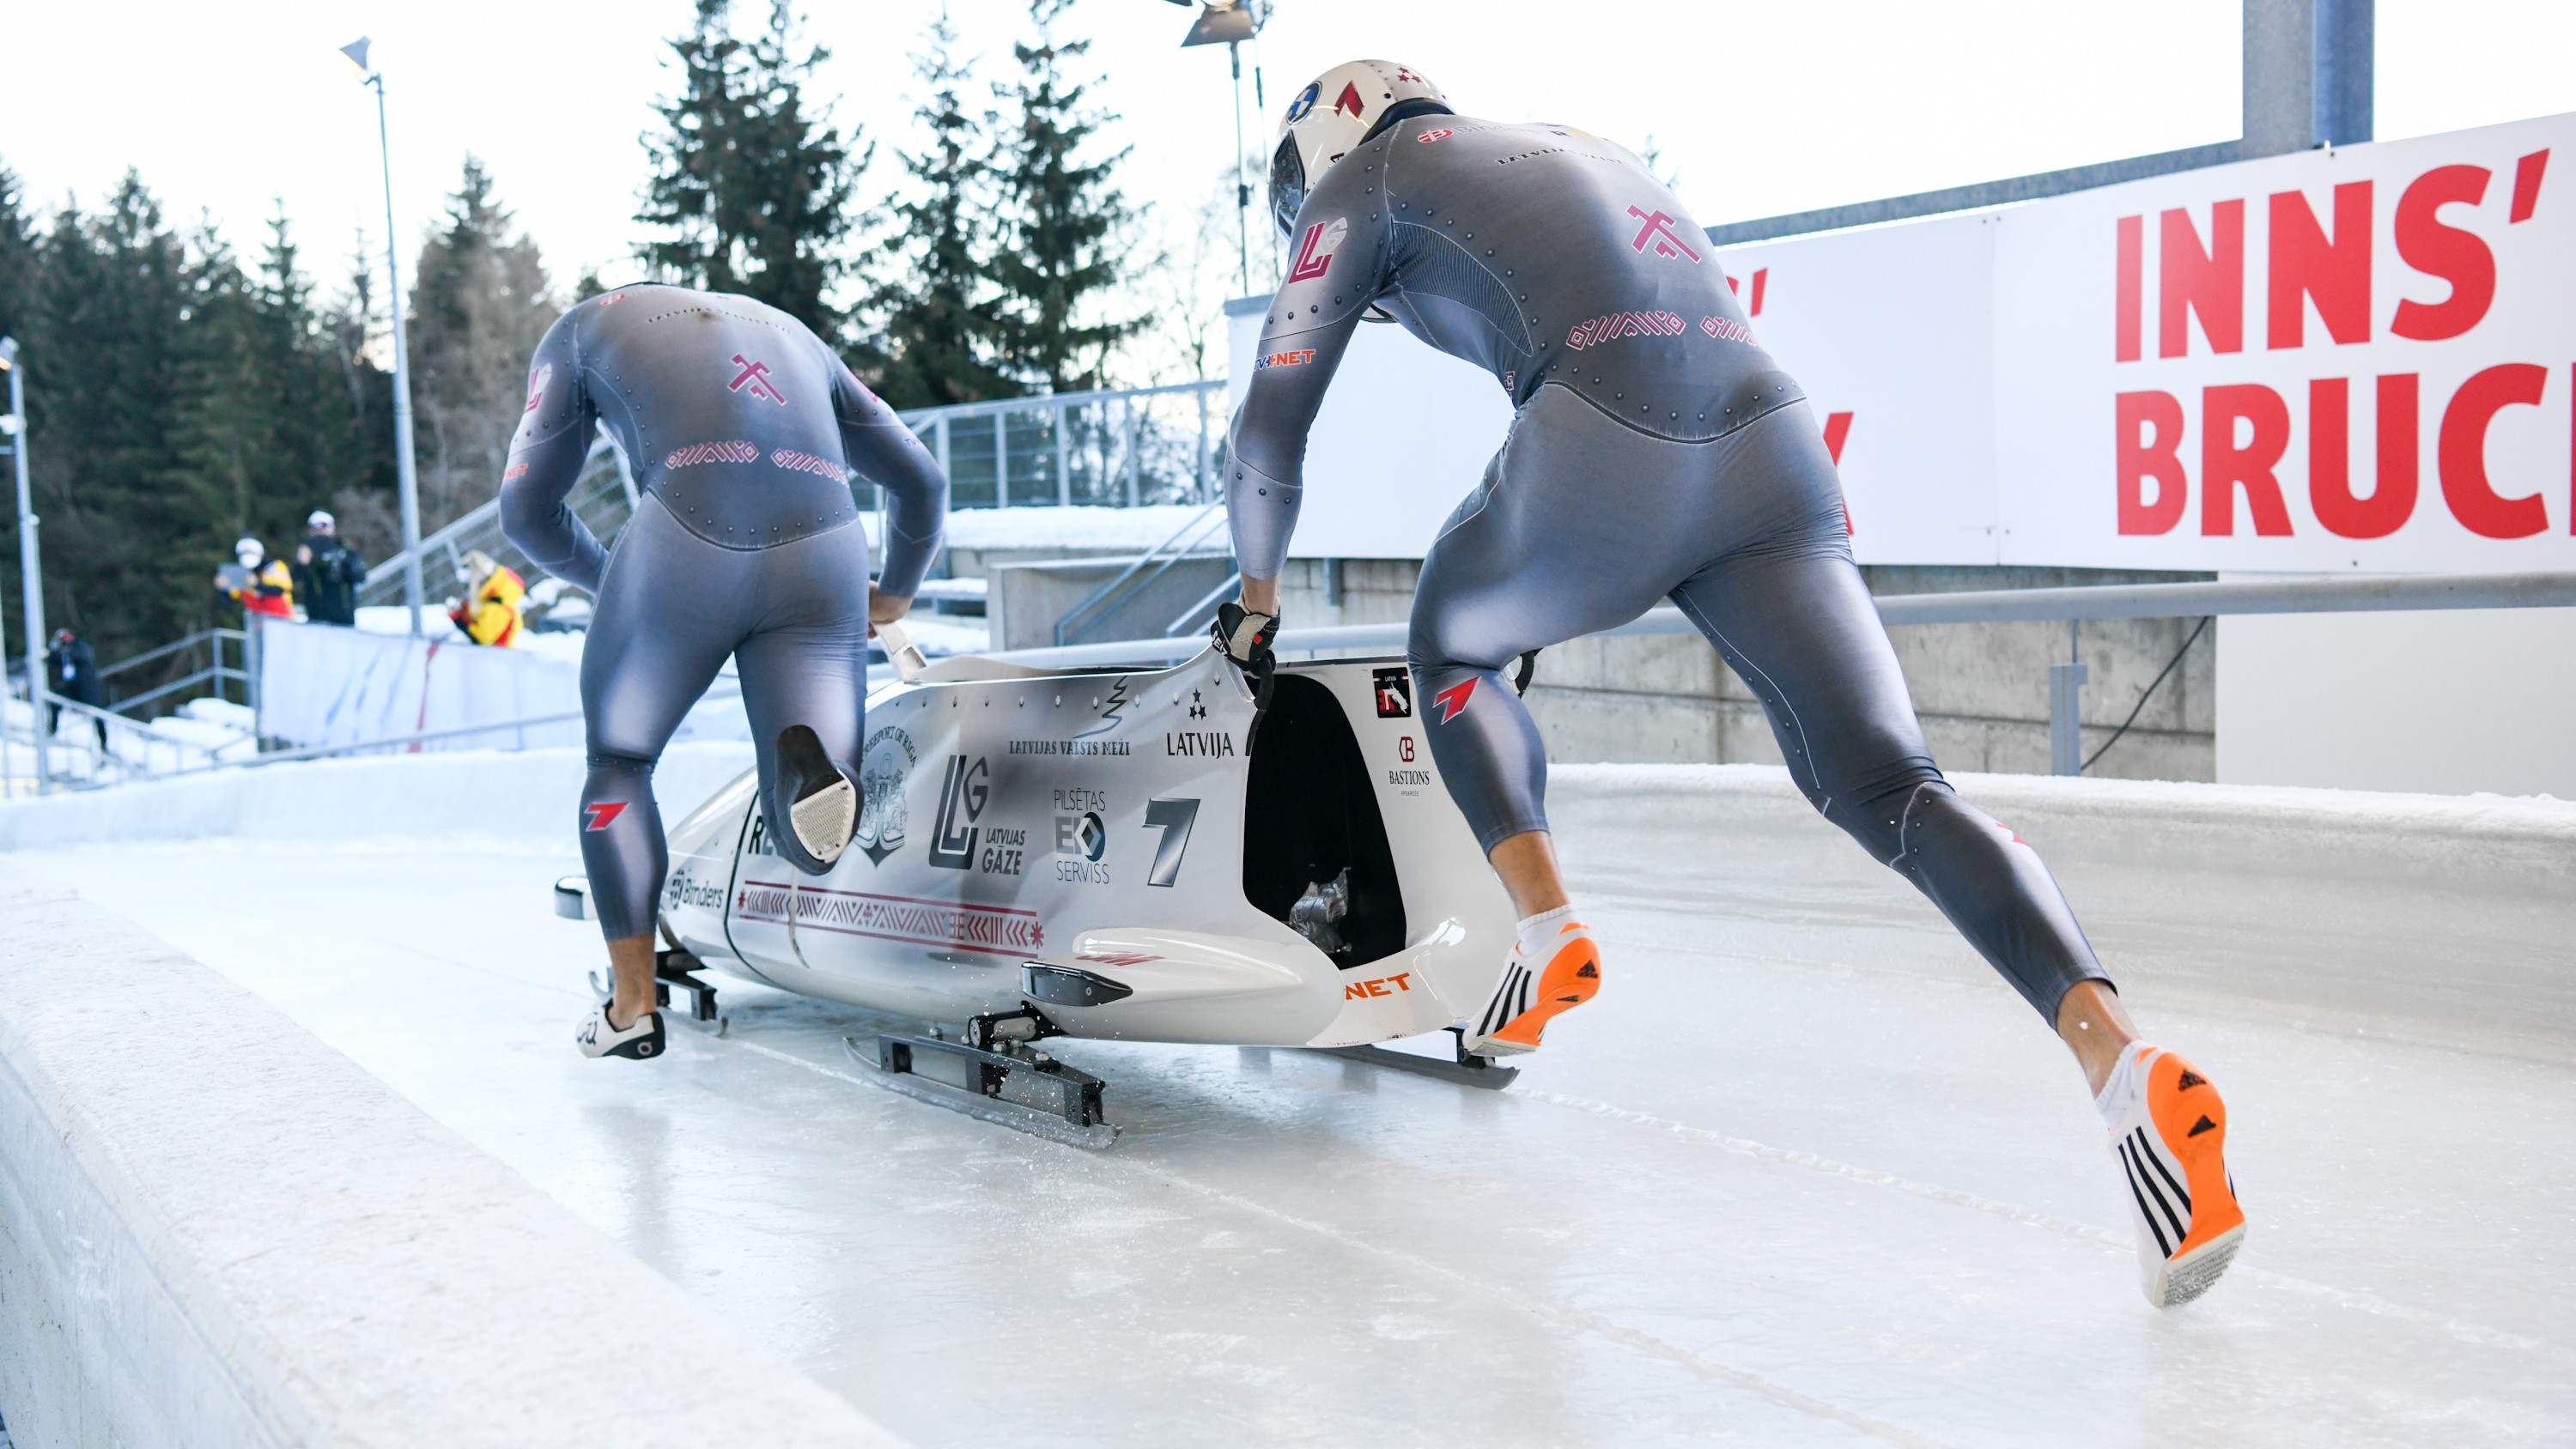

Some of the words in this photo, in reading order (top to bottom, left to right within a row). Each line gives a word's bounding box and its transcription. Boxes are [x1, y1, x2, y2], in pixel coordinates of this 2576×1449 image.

[2116, 148, 2550, 364] INNS'
[2116, 363, 2576, 541] BRUC
[1009, 741, 1057, 755] LATVIJAS
[1060, 741, 1098, 755] VALSTS
[1102, 739, 1130, 755] MEŽI
[1166, 732, 1235, 759] LATVIJA
[1388, 770, 1430, 785] BASTIONS
[1054, 787, 1106, 812] PILSĒTAS
[986, 828, 1026, 846] LATVIJAS
[1141, 797, 1201, 888] 7
[981, 845, 1024, 876] GĀZE
[1056, 859, 1110, 885] SERVISS
[683, 879, 724, 909] Binders
[1345, 972, 1411, 1000] NET
